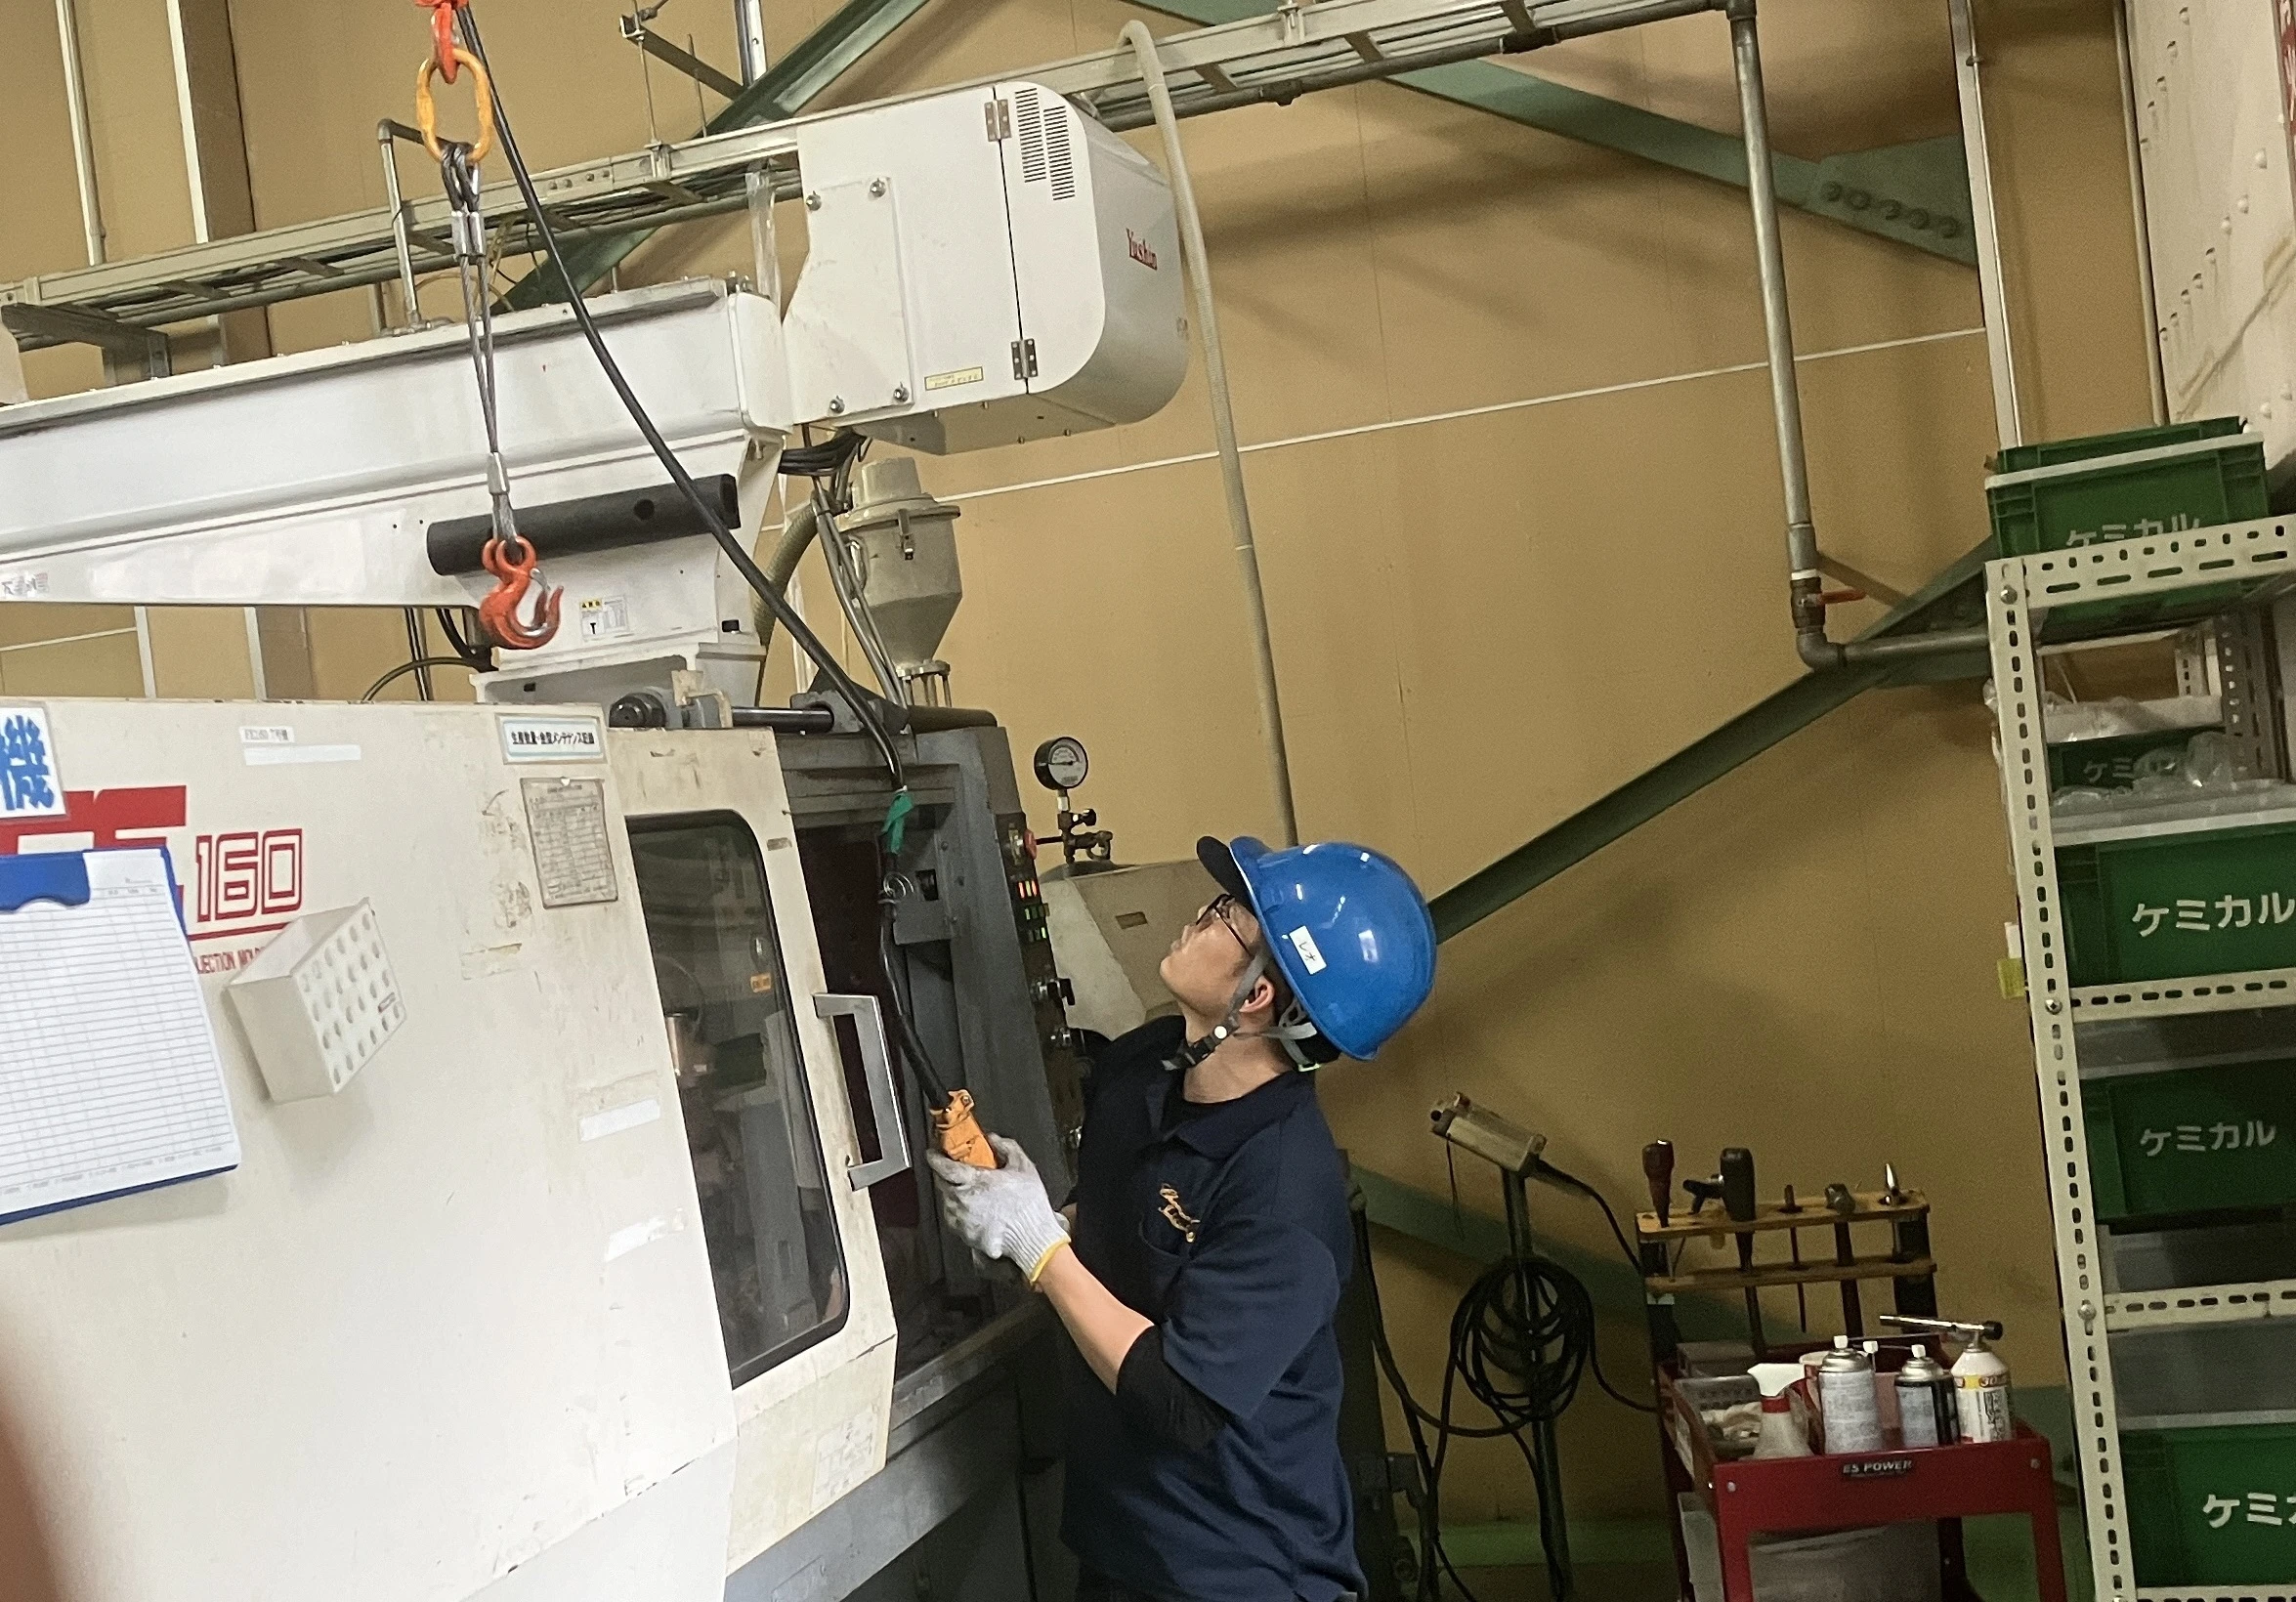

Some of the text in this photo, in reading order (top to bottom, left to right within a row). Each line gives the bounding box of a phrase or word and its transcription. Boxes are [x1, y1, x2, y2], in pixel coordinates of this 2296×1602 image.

[195, 827, 304, 923] 160
[2132, 892, 2296, 938] ケミカル
[2140, 1120, 2276, 1158] ケミカル
[2202, 1492, 2296, 1529] ケミ
